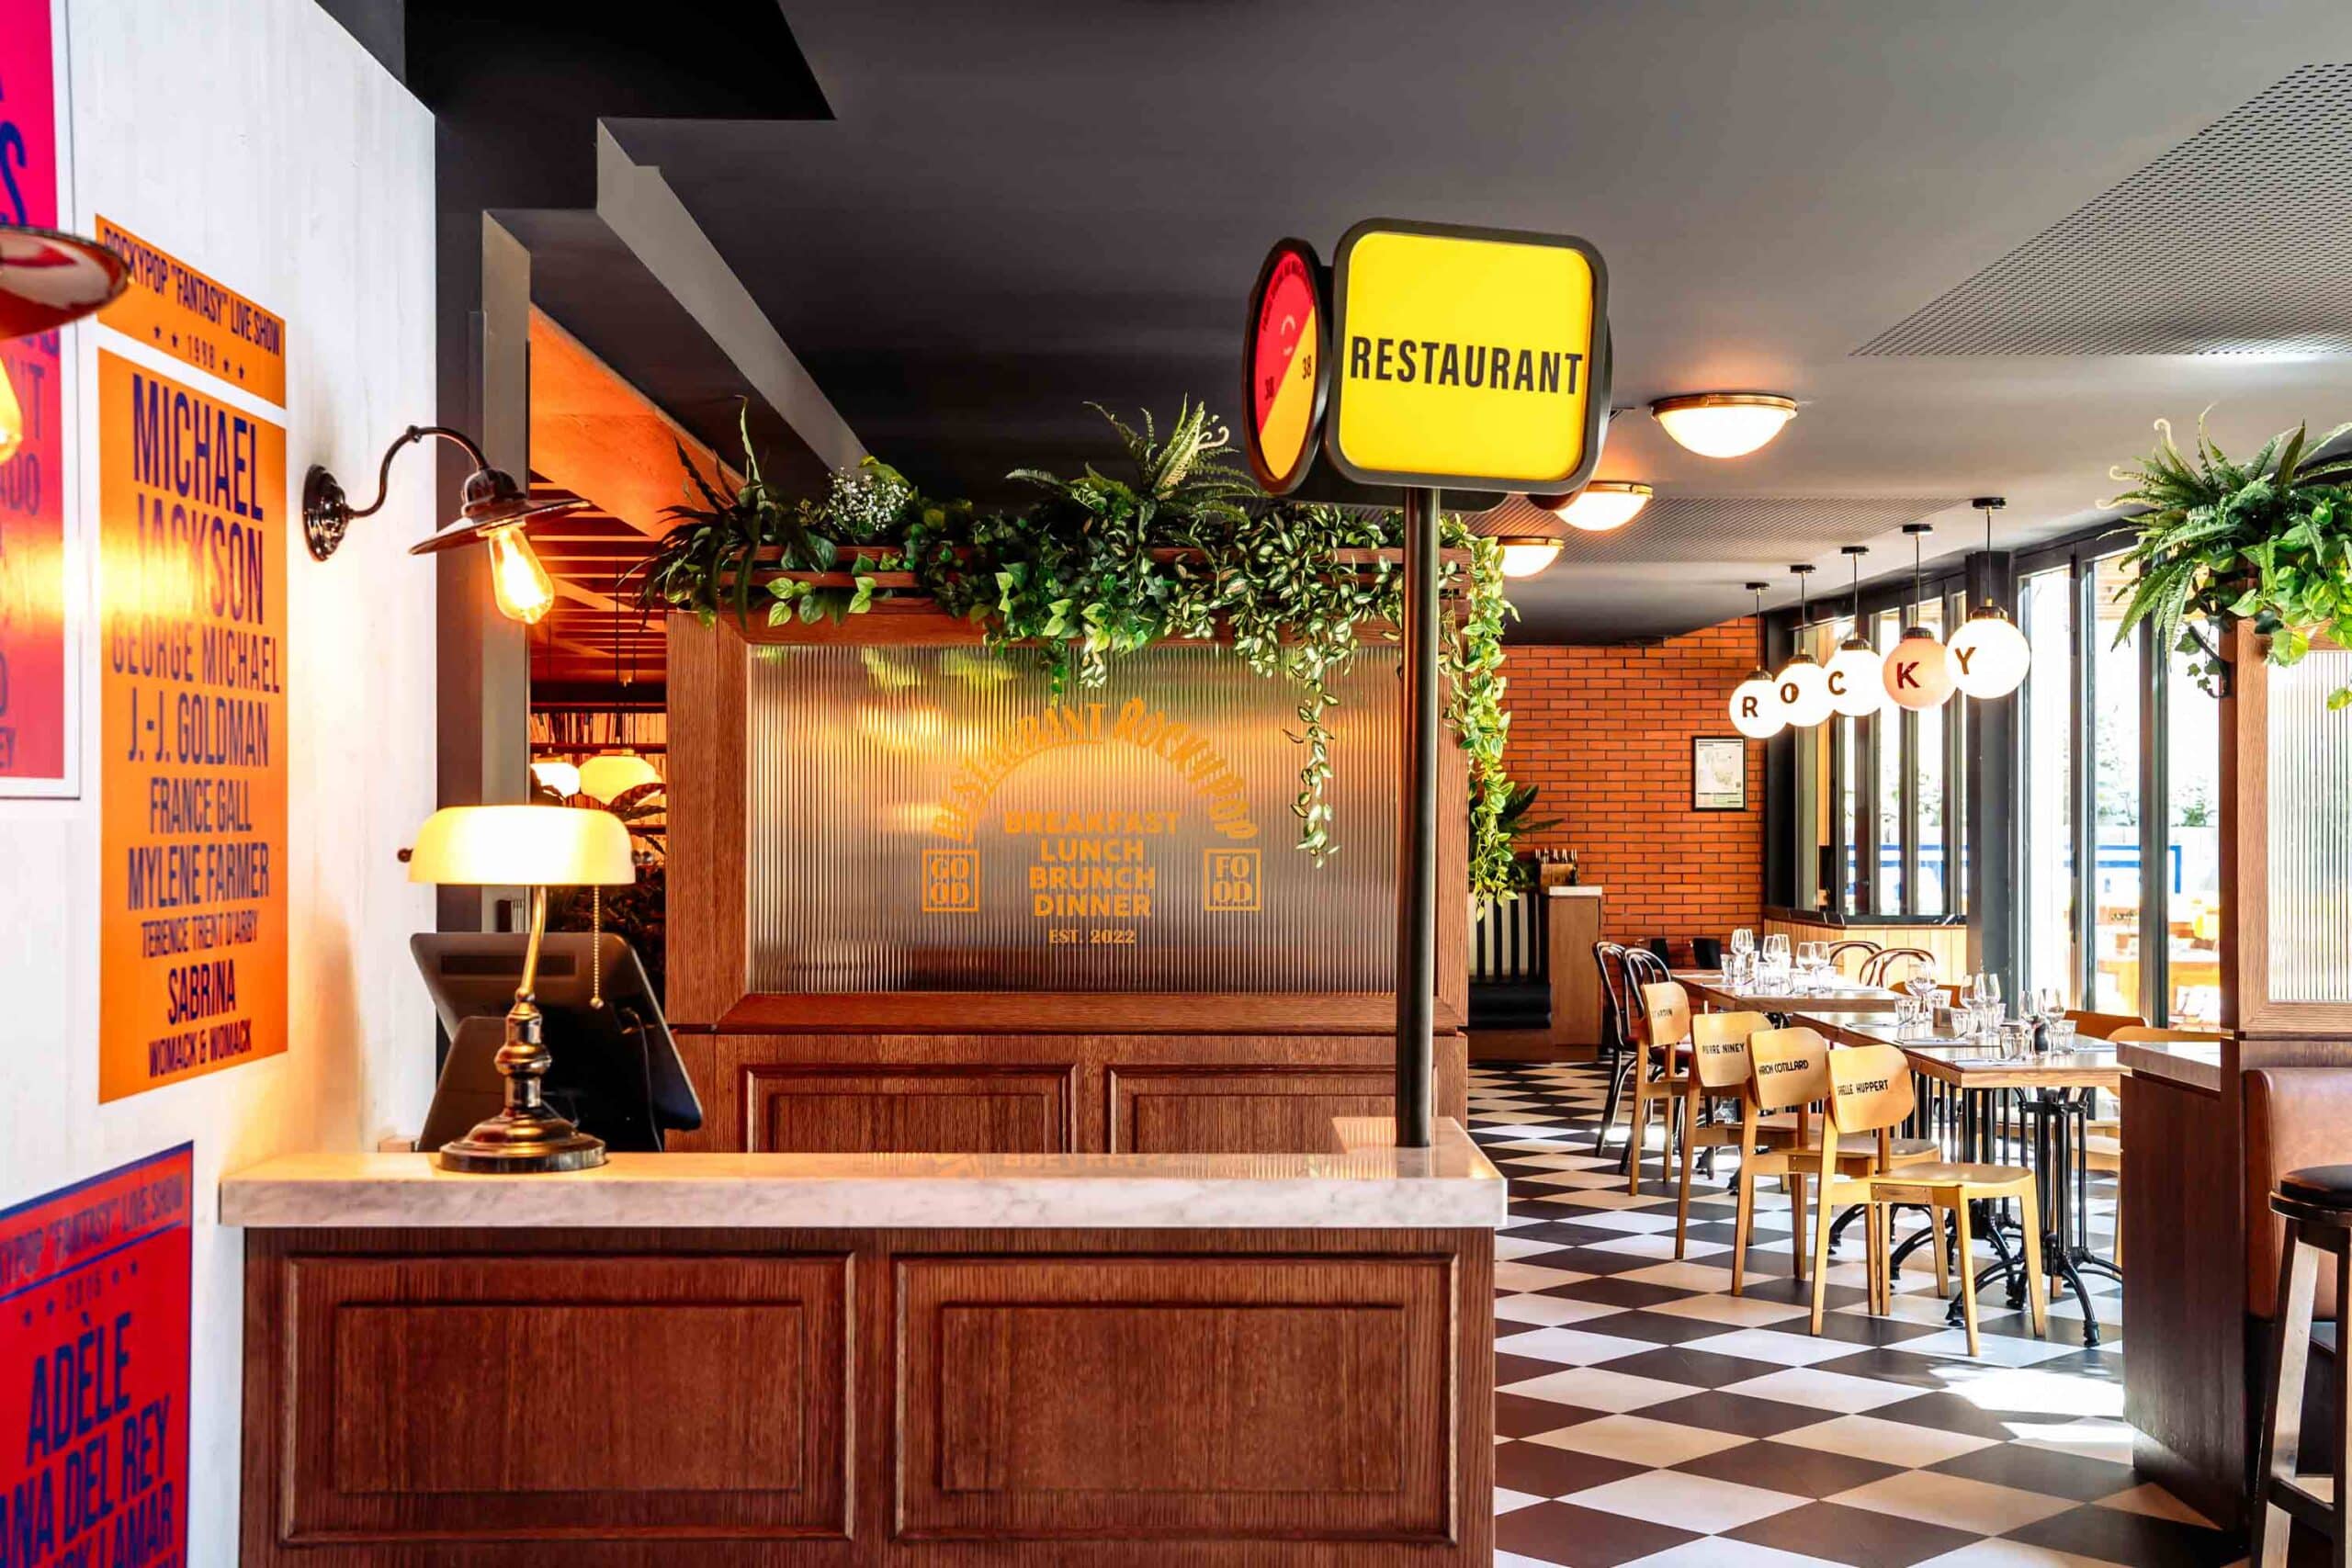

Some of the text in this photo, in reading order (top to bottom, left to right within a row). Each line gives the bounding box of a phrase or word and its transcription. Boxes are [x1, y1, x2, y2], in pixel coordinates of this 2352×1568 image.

[231, 297, 252, 343] LIVE
[254, 310, 280, 355] SHOW
[1302, 355, 1312, 379] 38
[1351, 336, 1583, 395] RESTAURANT
[133, 373, 263, 522] MICHAEL
[111, 612, 279, 694] GEORGE MICHAEL
[177, 692, 268, 767] GOLDMAN
[150, 776, 253, 834] FRANCE GALL
[1004, 810, 1180, 835] BREAKFAST
[128, 842, 269, 910] MYLENE FARMER
[1029, 866, 1155, 890] BRUNCH
[1041, 839, 1144, 862] LUNCH
[1034, 894, 1151, 917] DINNER
[141, 917, 188, 958] TERENCE
[192, 913, 222, 951] TRENT
[1049, 929, 1136, 944] EST. 2022
[168, 959, 236, 1025] SABRINA
[149, 1031, 198, 1078] WOMACK
[209, 1019, 253, 1062] WOMACK
[1723, 1043, 1745, 1054] NINEY
[1774, 1059, 1809, 1073] COTILLARD
[1856, 1079, 1888, 1094] HUPPERT
[26, 1312, 131, 1467] ADÈLE
[64, 1432, 114, 1544] DEL
[120, 1392, 170, 1503] REY
